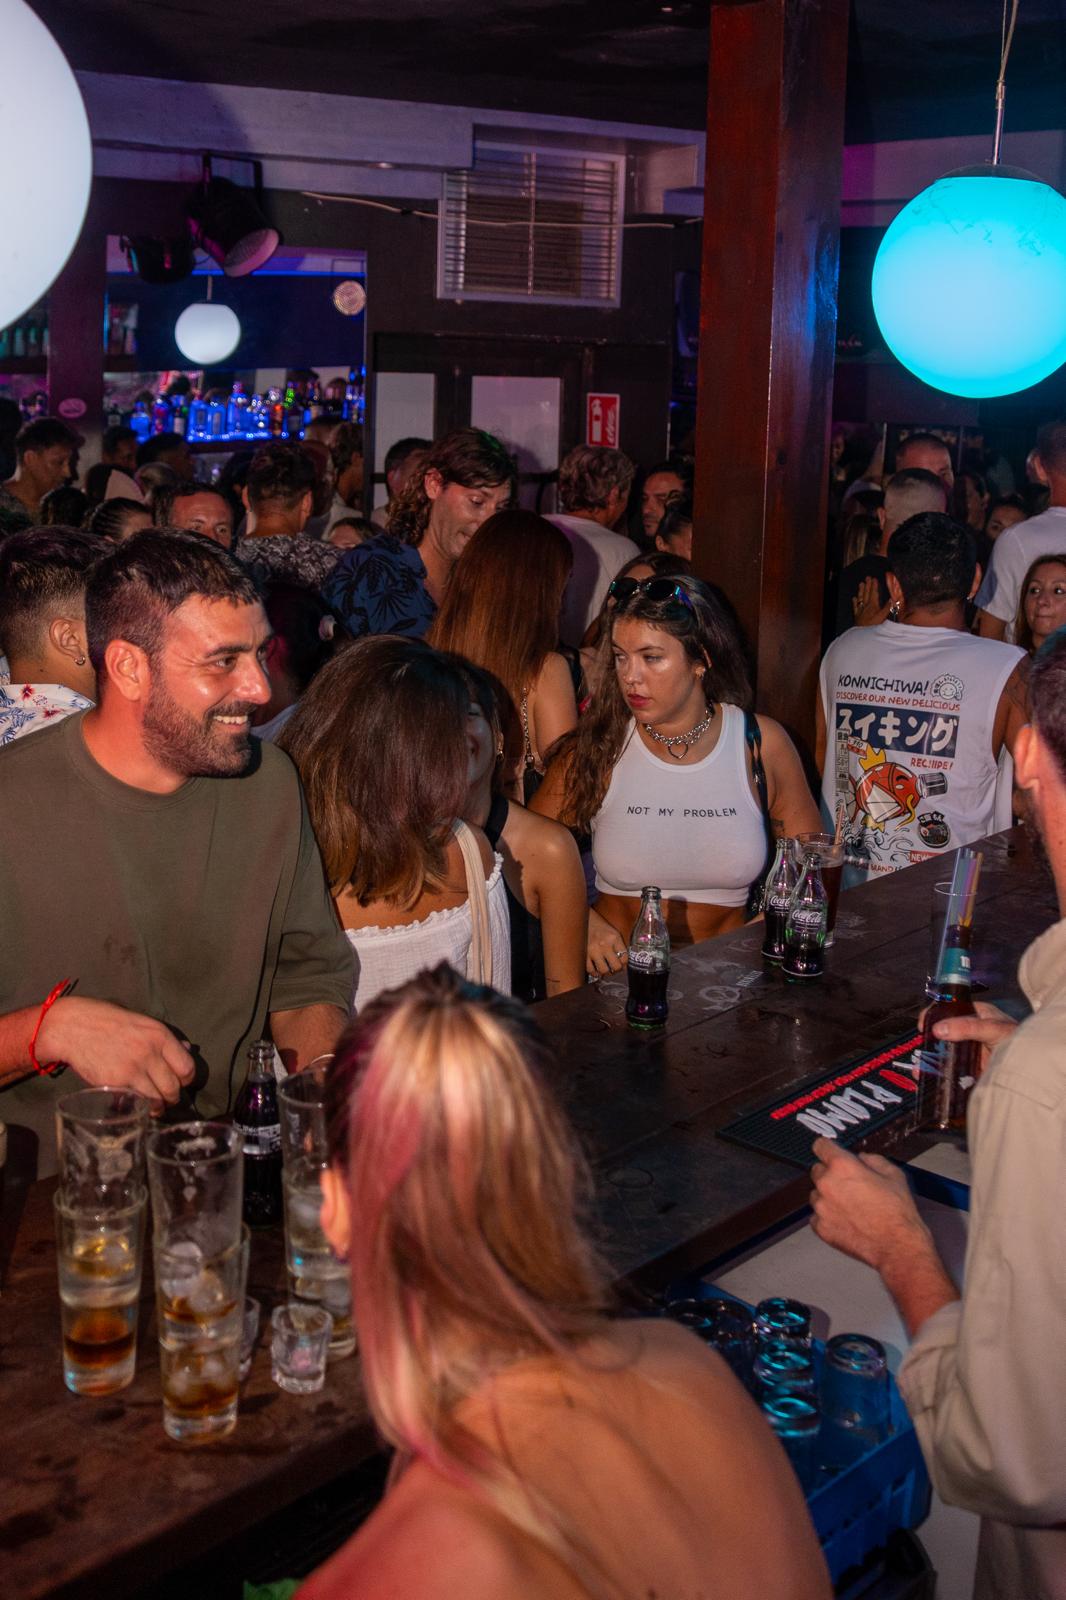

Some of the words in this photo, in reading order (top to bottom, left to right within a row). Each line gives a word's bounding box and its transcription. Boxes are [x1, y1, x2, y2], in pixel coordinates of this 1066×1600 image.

[838, 674, 929, 697] KONNICHIWA!
[836, 691, 868, 701] DISCOVER
[868, 694, 886, 703] OUR
[888, 697, 911, 706] NEW
[912, 699, 960, 711] DELICIOUS
[626, 806, 650, 816] NOT
[658, 808, 674, 817] MY
[683, 807, 737, 818] PROBLEM
